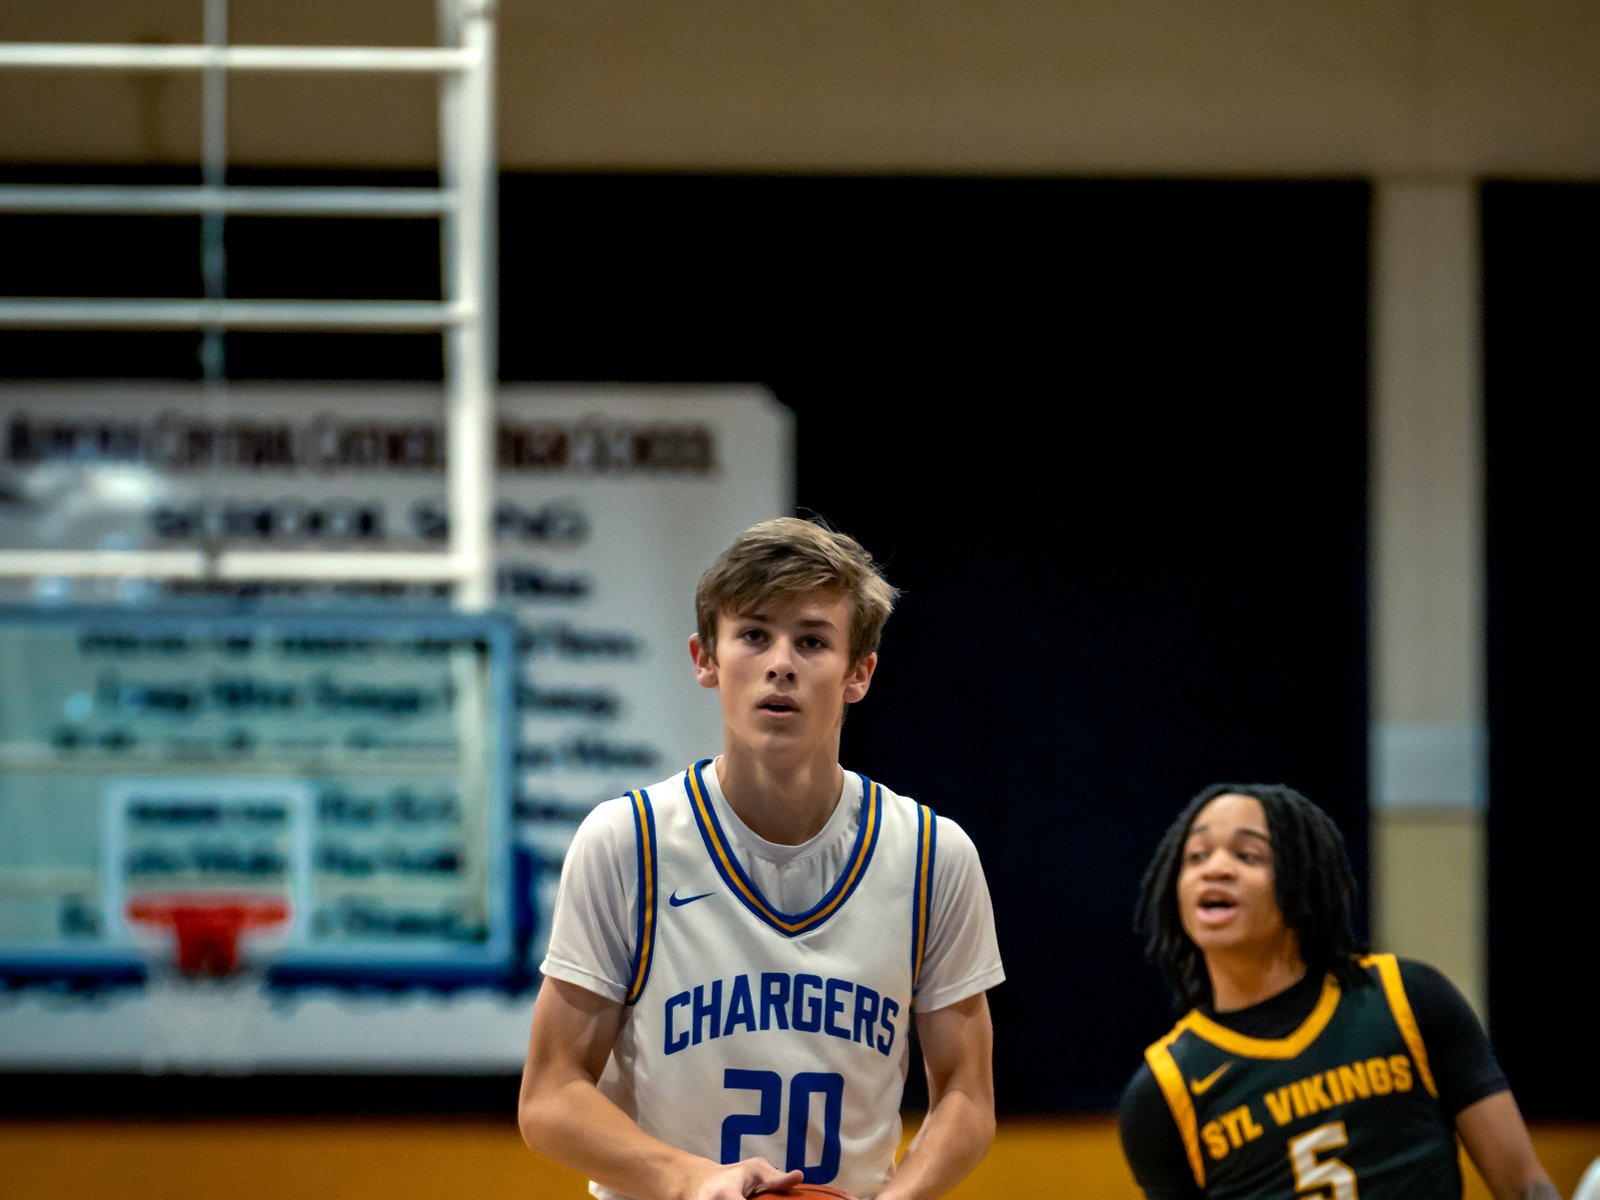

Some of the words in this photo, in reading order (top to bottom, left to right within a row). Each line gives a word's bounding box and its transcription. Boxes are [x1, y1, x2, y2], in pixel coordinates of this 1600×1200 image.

[664, 972, 899, 1056] CHARGERS
[720, 1068, 845, 1186] 20
[1201, 1104, 1264, 1161] STL
[1263, 1054, 1413, 1127] VIKINGS
